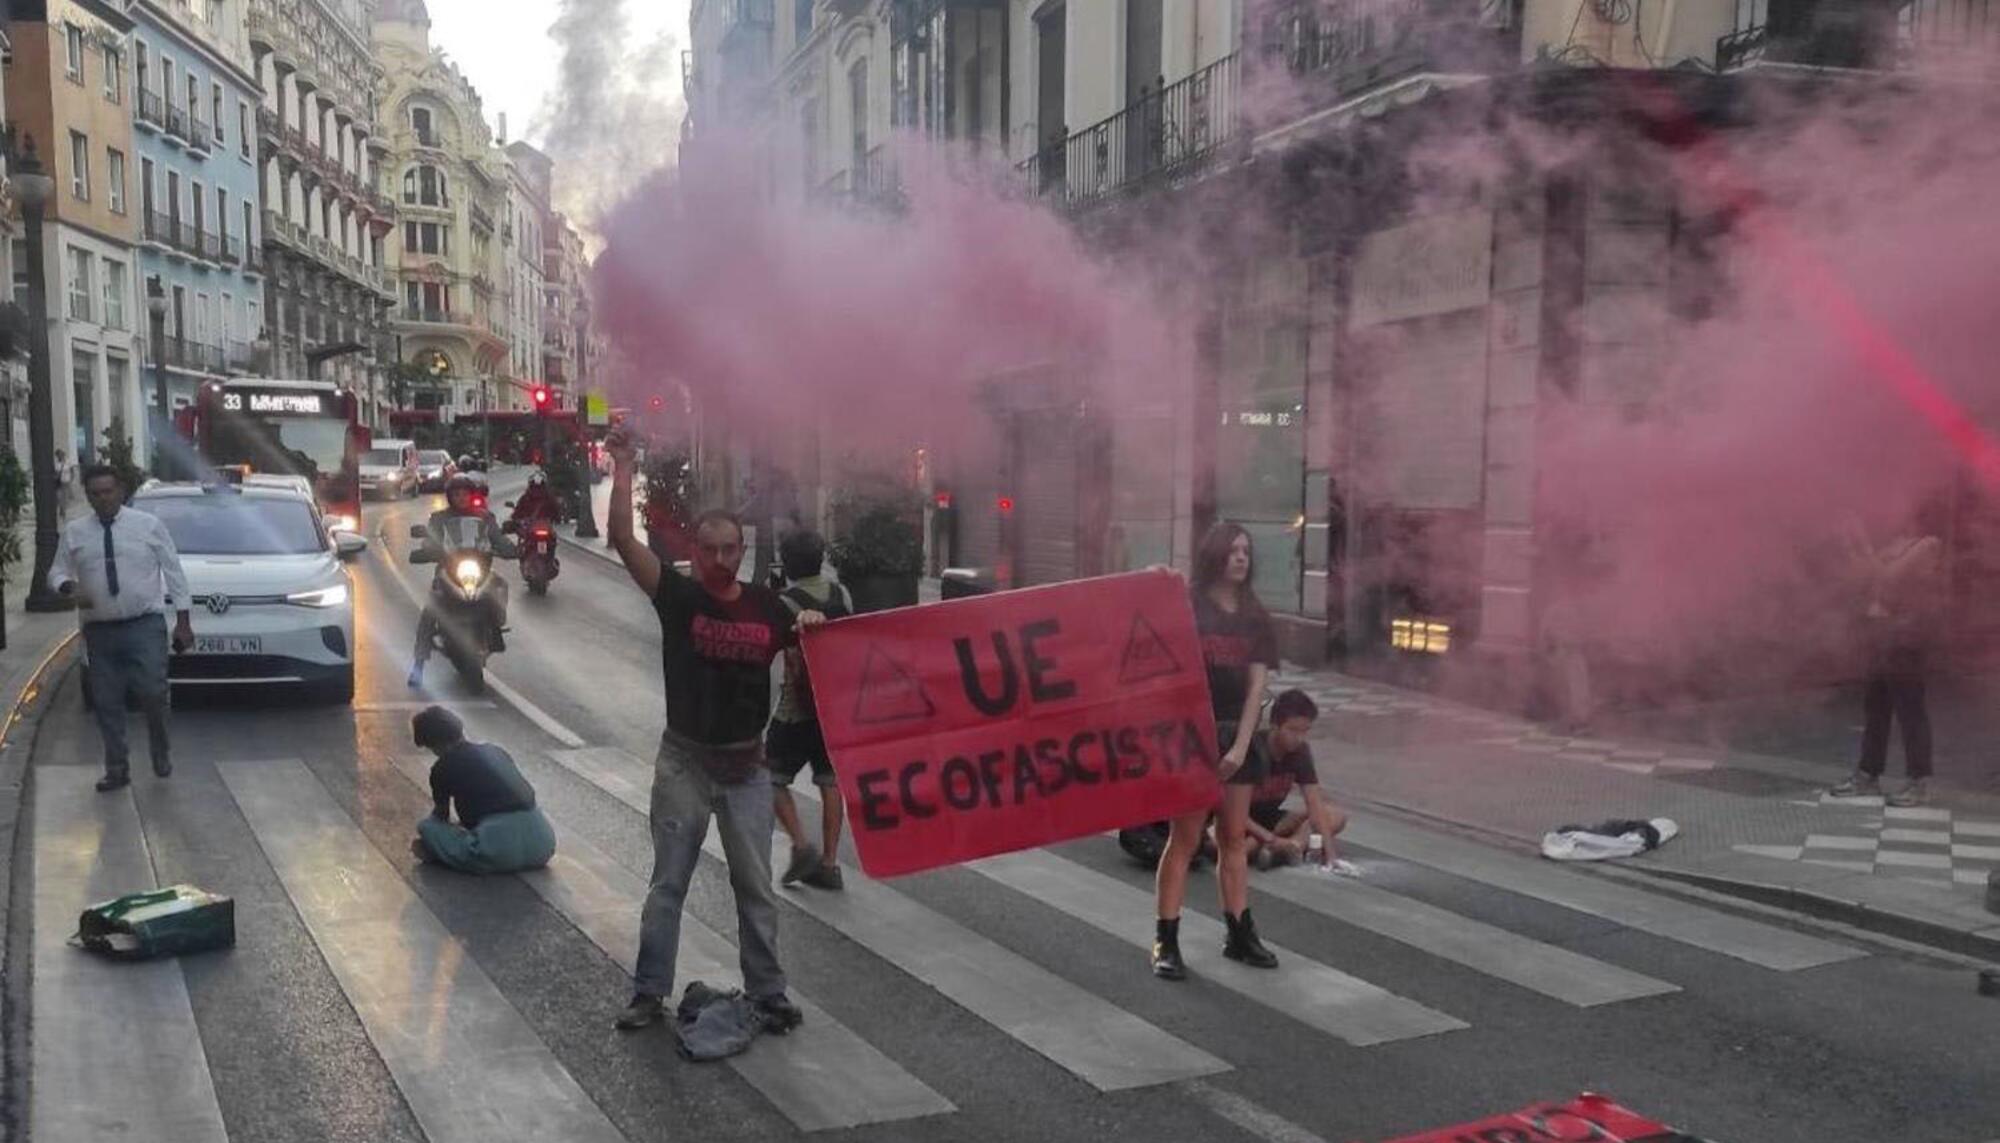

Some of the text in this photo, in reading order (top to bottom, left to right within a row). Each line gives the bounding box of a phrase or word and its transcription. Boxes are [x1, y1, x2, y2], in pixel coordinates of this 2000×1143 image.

[223, 393, 242, 410] 33
[953, 618, 1076, 717] UE
[857, 717, 1217, 831] ECOFASCISTA
